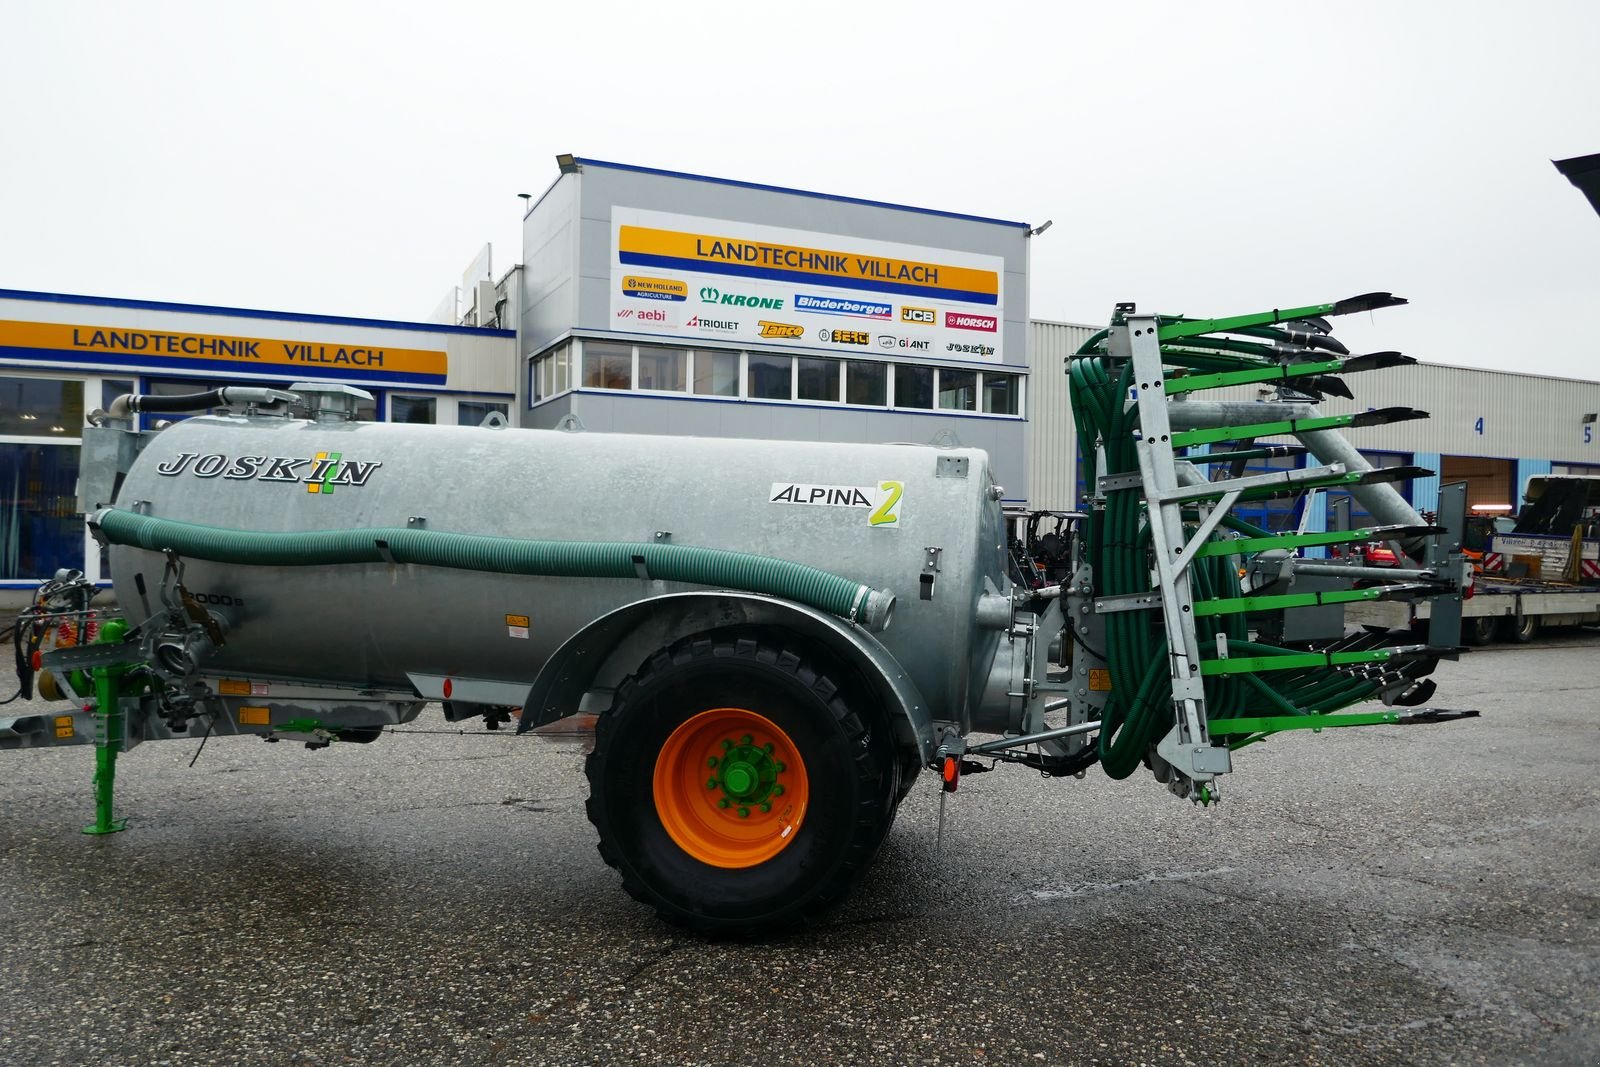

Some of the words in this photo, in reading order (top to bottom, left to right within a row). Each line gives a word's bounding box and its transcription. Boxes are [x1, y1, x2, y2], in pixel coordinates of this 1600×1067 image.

[696, 239, 848, 273] LANDTECHNIK
[856, 258, 938, 284] VILLACH
[637, 281, 653, 289] NEW
[654, 283, 683, 292] HOLLAND
[637, 291, 672, 300] AGRICULTURE
[721, 293, 784, 310] KRONE
[798, 297, 890, 315] Binderberger
[637, 309, 665, 321] aebi
[903, 309, 934, 322] JCB
[956, 317, 995, 329] HORSCH
[698, 319, 739, 330] TRIOLIET
[758, 320, 804, 339] Tanco
[72, 328, 261, 359] LANDTECHNIK
[283, 343, 384, 367] VILLACH
[946, 343, 995, 356] JOSKIN
[1475, 417, 1484, 435] 4
[1584, 426, 1592, 443] 5
[157, 452, 382, 487] JOSKIN
[771, 484, 872, 507] ALPINA
[869, 481, 903, 525] 2
